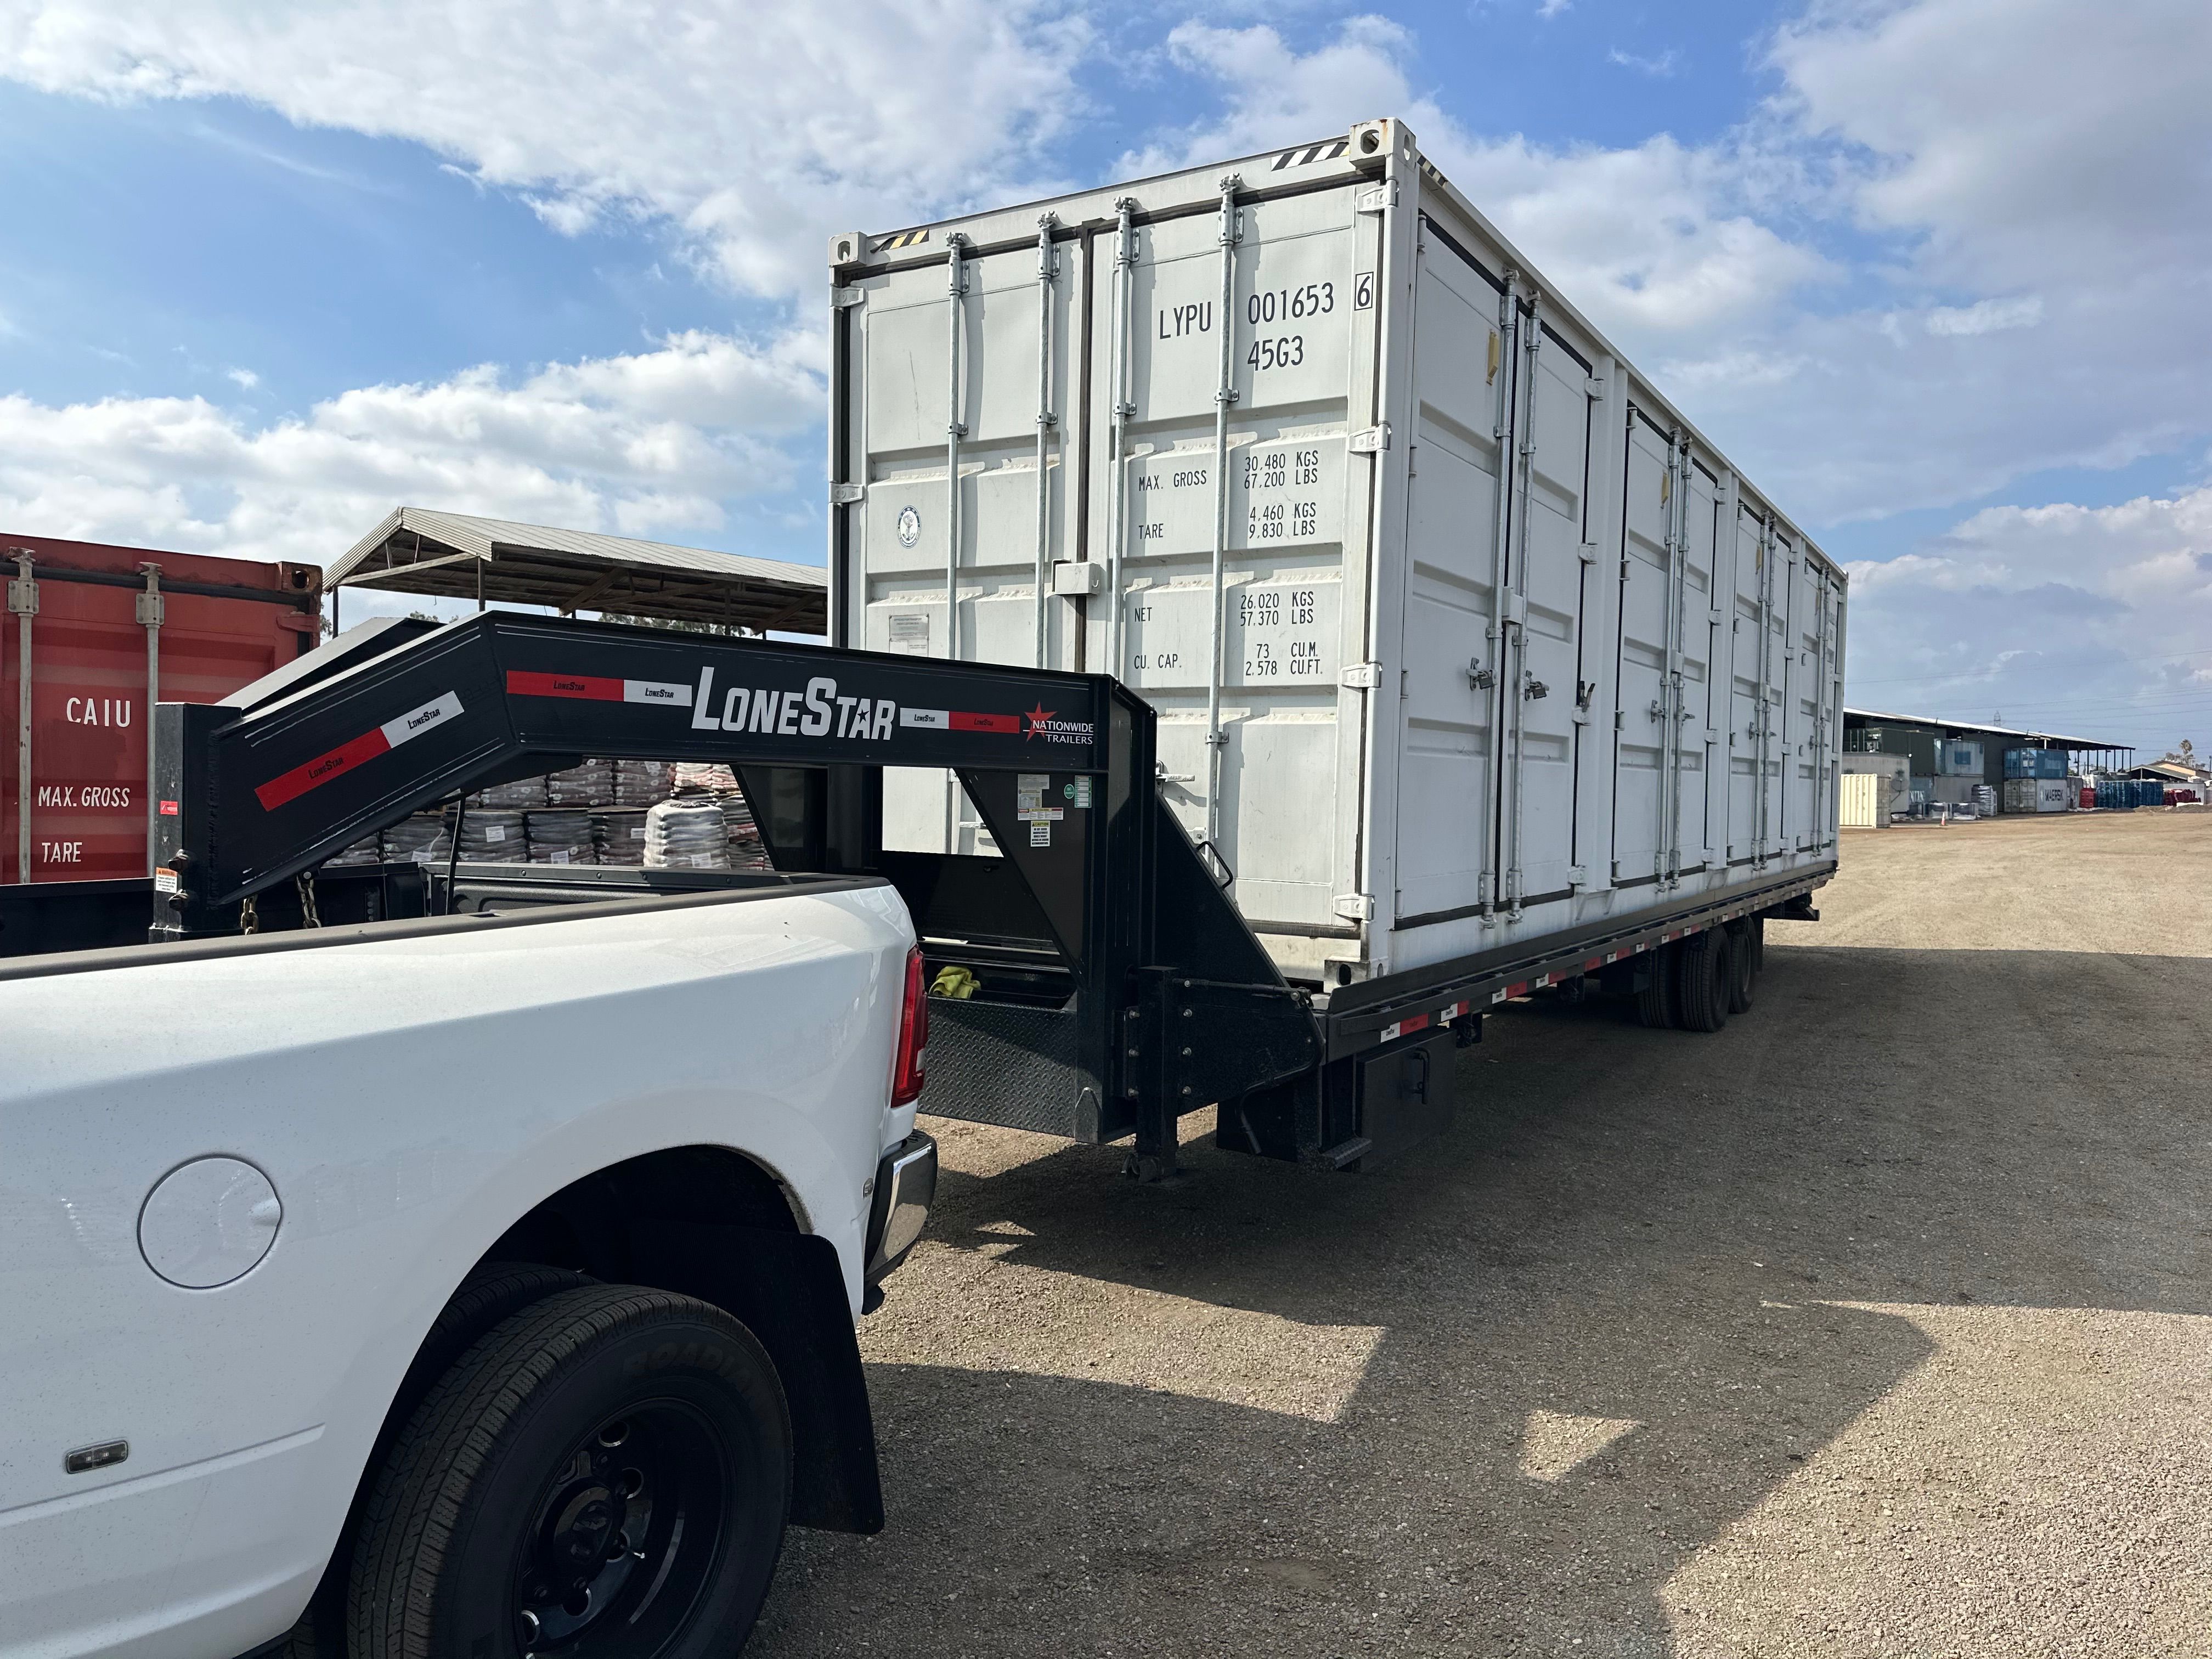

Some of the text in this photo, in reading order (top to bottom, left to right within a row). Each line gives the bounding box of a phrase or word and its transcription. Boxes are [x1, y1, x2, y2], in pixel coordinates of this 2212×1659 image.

[1159, 275, 1371, 339] LYPU 001653 6
[1247, 335, 1304, 371] 45G3
[1296, 450, 1318, 467] KGS
[1138, 470, 1207, 492] MAX. GROSS
[1295, 469, 1318, 485] LBS
[1294, 502, 1316, 519] KGS
[1138, 523, 1164, 539] TARE
[1293, 520, 1316, 536] LBS
[1291, 591, 1314, 607] KGS
[1135, 607, 1152, 622] NET
[1291, 609, 1313, 624] LBS
[1256, 641, 1318, 659] 73 CU.M.
[1134, 653, 1182, 669] CU. CAP.
[66, 697, 131, 727] CAIU
[1032, 719, 1094, 734] NATIONWIDE
[1045, 733, 1093, 745] TRAILERS
[38, 785, 131, 808] MAX. GROSS
[41, 841, 83, 864] TARE
